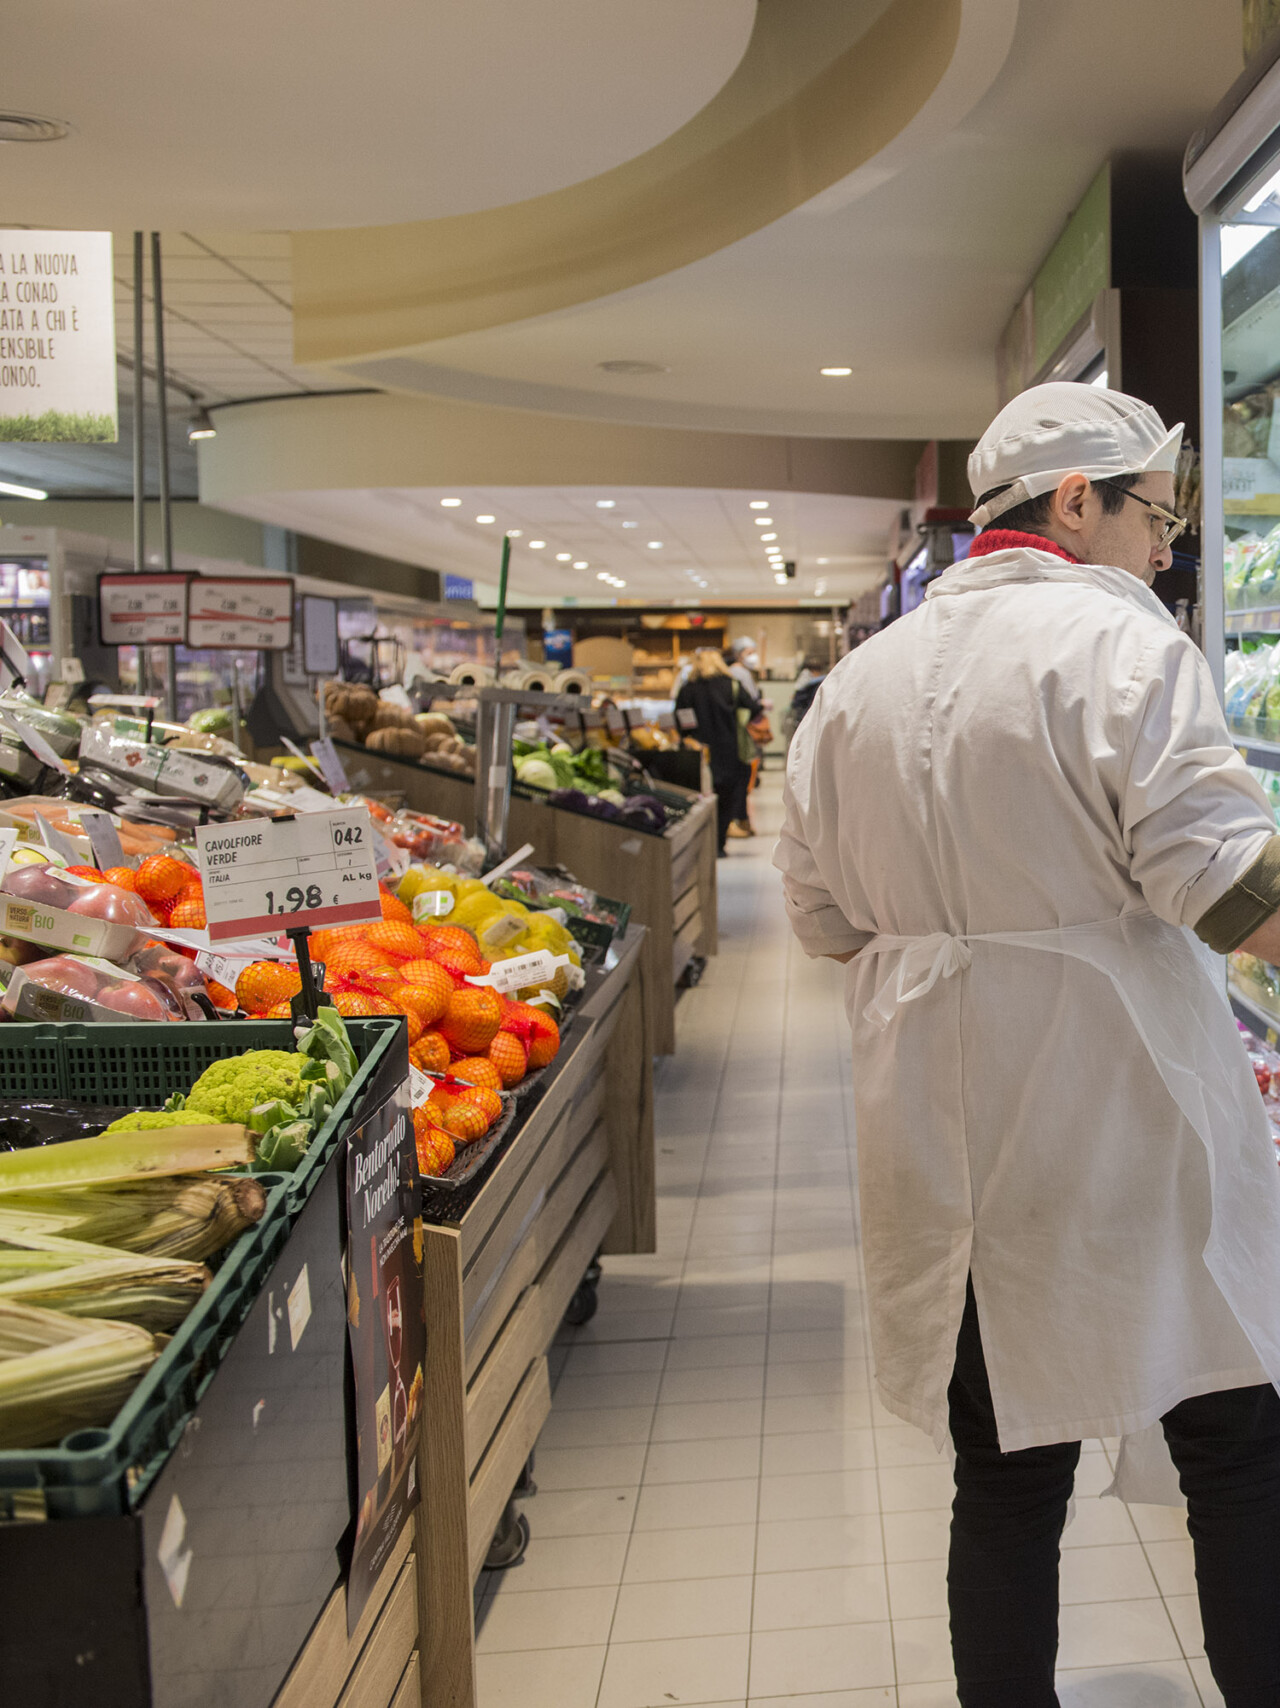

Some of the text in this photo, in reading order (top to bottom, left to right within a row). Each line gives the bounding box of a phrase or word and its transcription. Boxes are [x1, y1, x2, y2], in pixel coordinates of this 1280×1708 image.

[12, 253, 28, 275] LA
[34, 253, 79, 275] NUOVA
[16, 281, 58, 304] CONAD
[31, 309, 40, 331] A
[46, 309, 66, 331] CHI
[72, 305, 79, 331] È
[0, 365, 41, 388] ONDO.
[205, 834, 263, 853] CAVOLFIORE
[334, 826, 363, 846] 042
[206, 851, 238, 866] VERDE
[209, 874, 230, 884] ITALIA
[342, 872, 373, 882] AL kg
[265, 884, 323, 916] 1,98
[332, 894, 339, 905] €
[34, 914, 55, 930] BIO
[63, 1003, 85, 1019] BIO
[354, 1113, 406, 1195] Bentornato
[363, 1150, 401, 1229] Novello!
